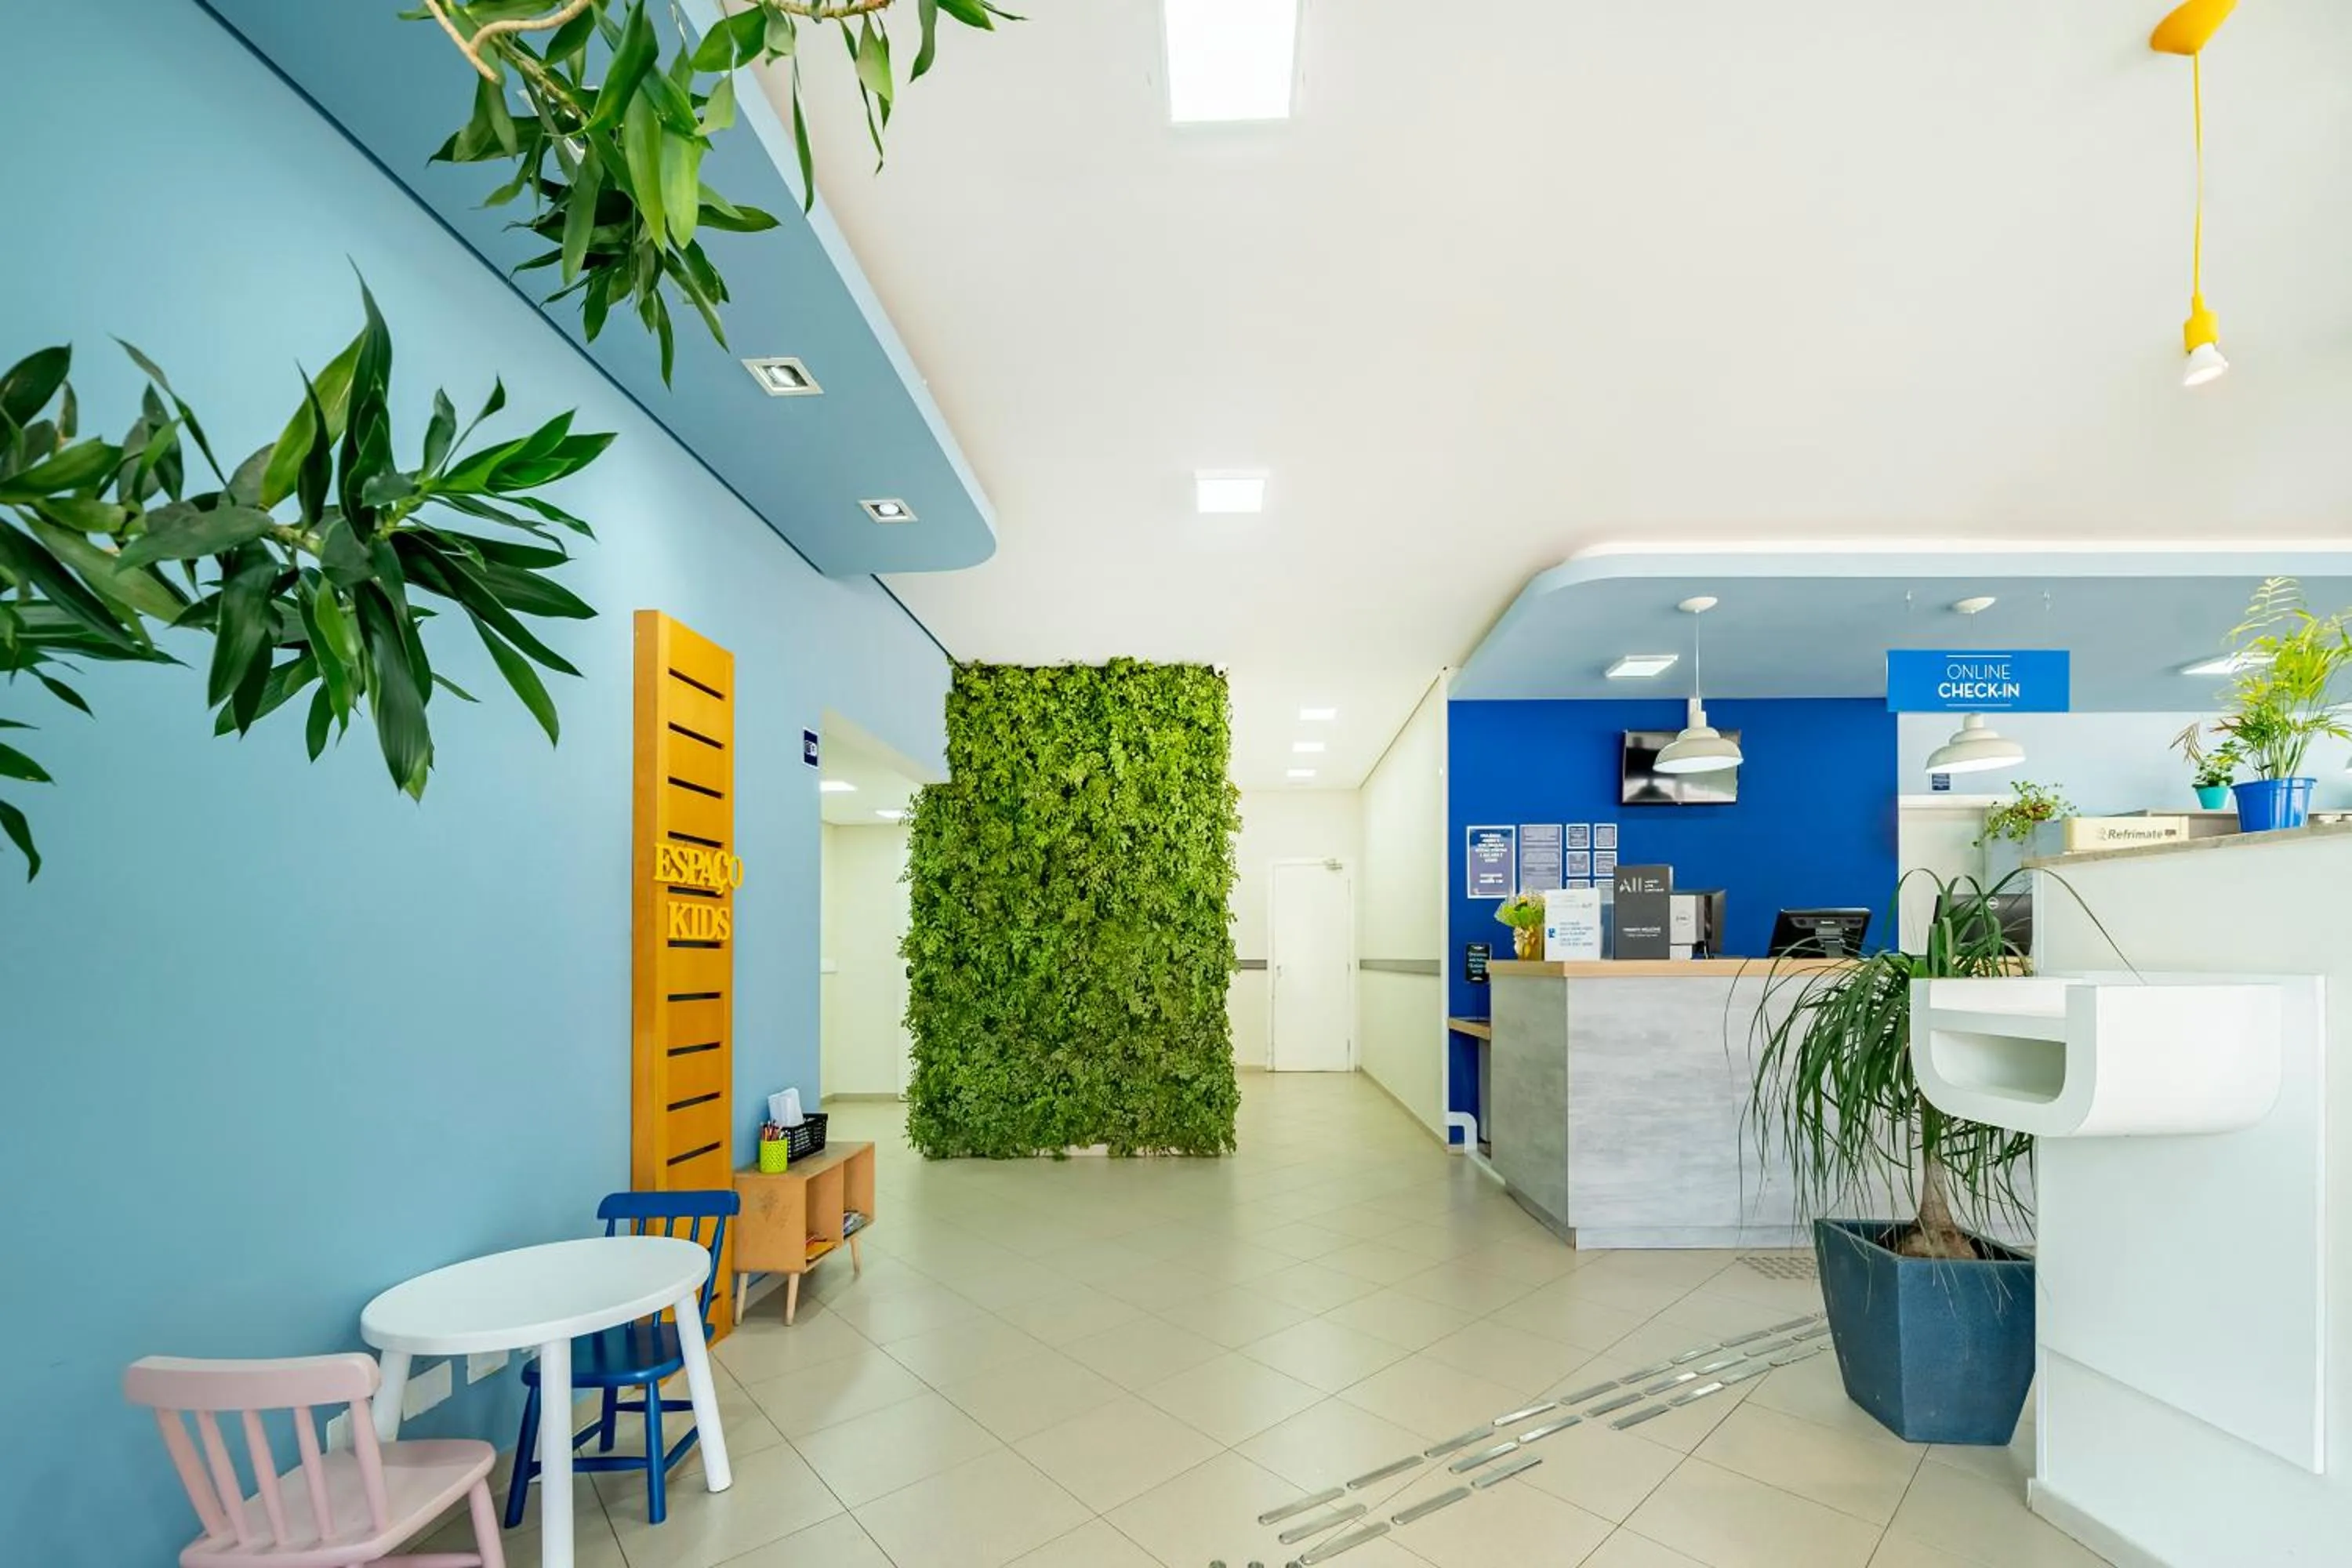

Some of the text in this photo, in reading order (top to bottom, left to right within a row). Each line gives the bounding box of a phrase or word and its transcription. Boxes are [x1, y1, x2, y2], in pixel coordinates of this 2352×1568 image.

[1946, 664, 2011, 680] ONLINE
[1938, 683, 2020, 698] CHECK-IN
[2107, 829, 2163, 840] Refrimate
[654, 843, 744, 895] ESPAÇO
[668, 902, 731, 940] KIDS
